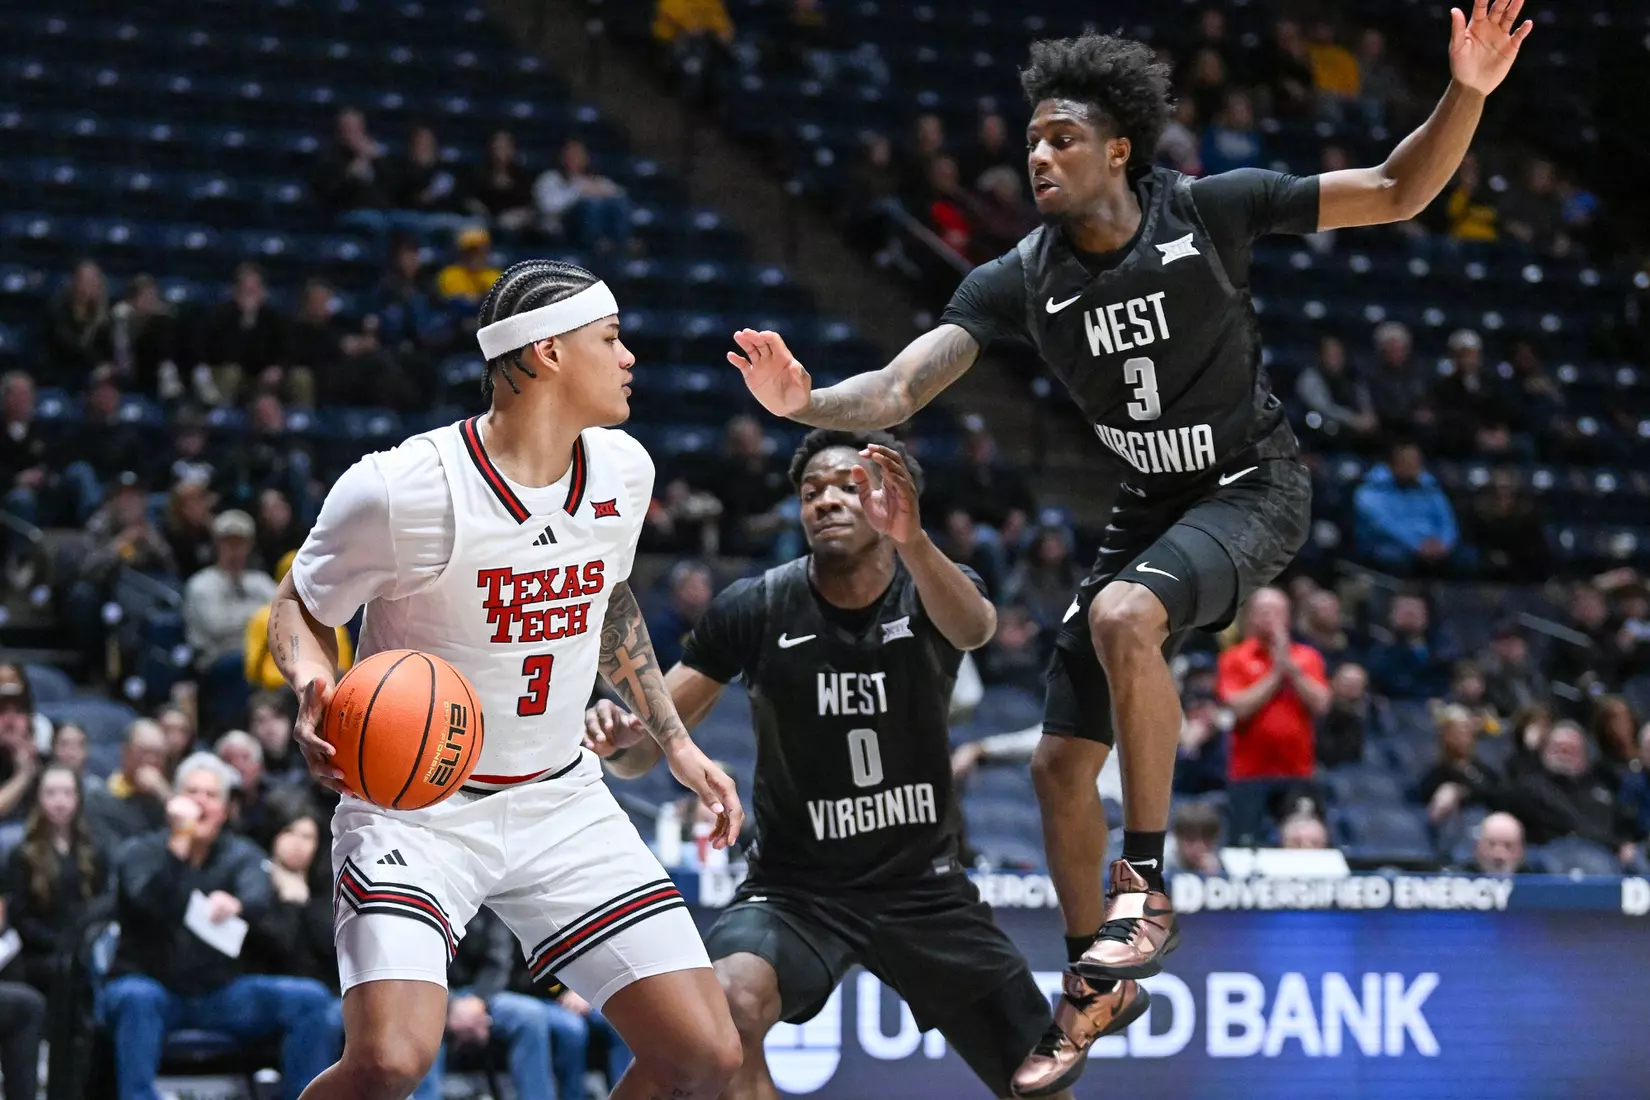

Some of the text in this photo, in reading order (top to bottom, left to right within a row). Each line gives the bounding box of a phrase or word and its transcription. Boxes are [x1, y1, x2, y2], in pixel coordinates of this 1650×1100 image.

[1083, 291, 1170, 357] WEST
[1123, 356, 1161, 421] 3
[1093, 423, 1217, 474] VIRGINIA
[477, 559, 605, 609] TEXAS
[486, 601, 591, 643] TECH
[516, 654, 554, 717] 3
[817, 671, 888, 716] WEST
[429, 702, 468, 787] ELITE
[847, 728, 884, 788] 0
[807, 783, 937, 841] VIRGINIA
[1203, 875, 1392, 910] DIVERSIFIED
[1393, 876, 1513, 911] ENERGY
[1206, 971, 1441, 1058] BANK
